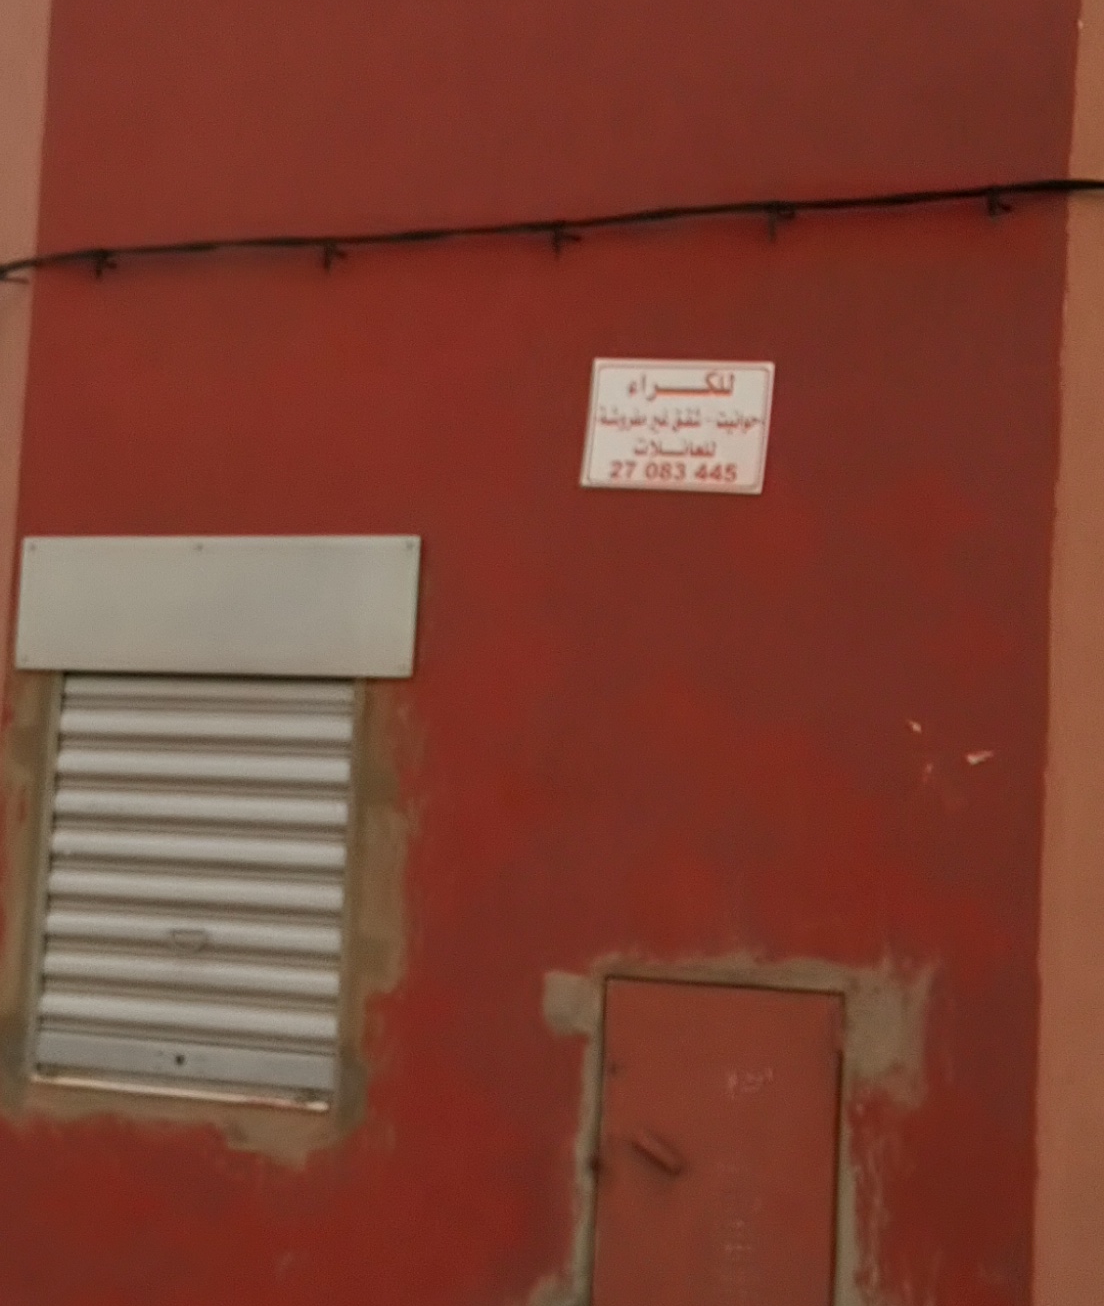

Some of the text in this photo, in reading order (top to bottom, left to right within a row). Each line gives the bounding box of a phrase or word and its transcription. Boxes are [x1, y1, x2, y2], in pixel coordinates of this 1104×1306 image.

[609, 460, 738, 482] 27 083 445
